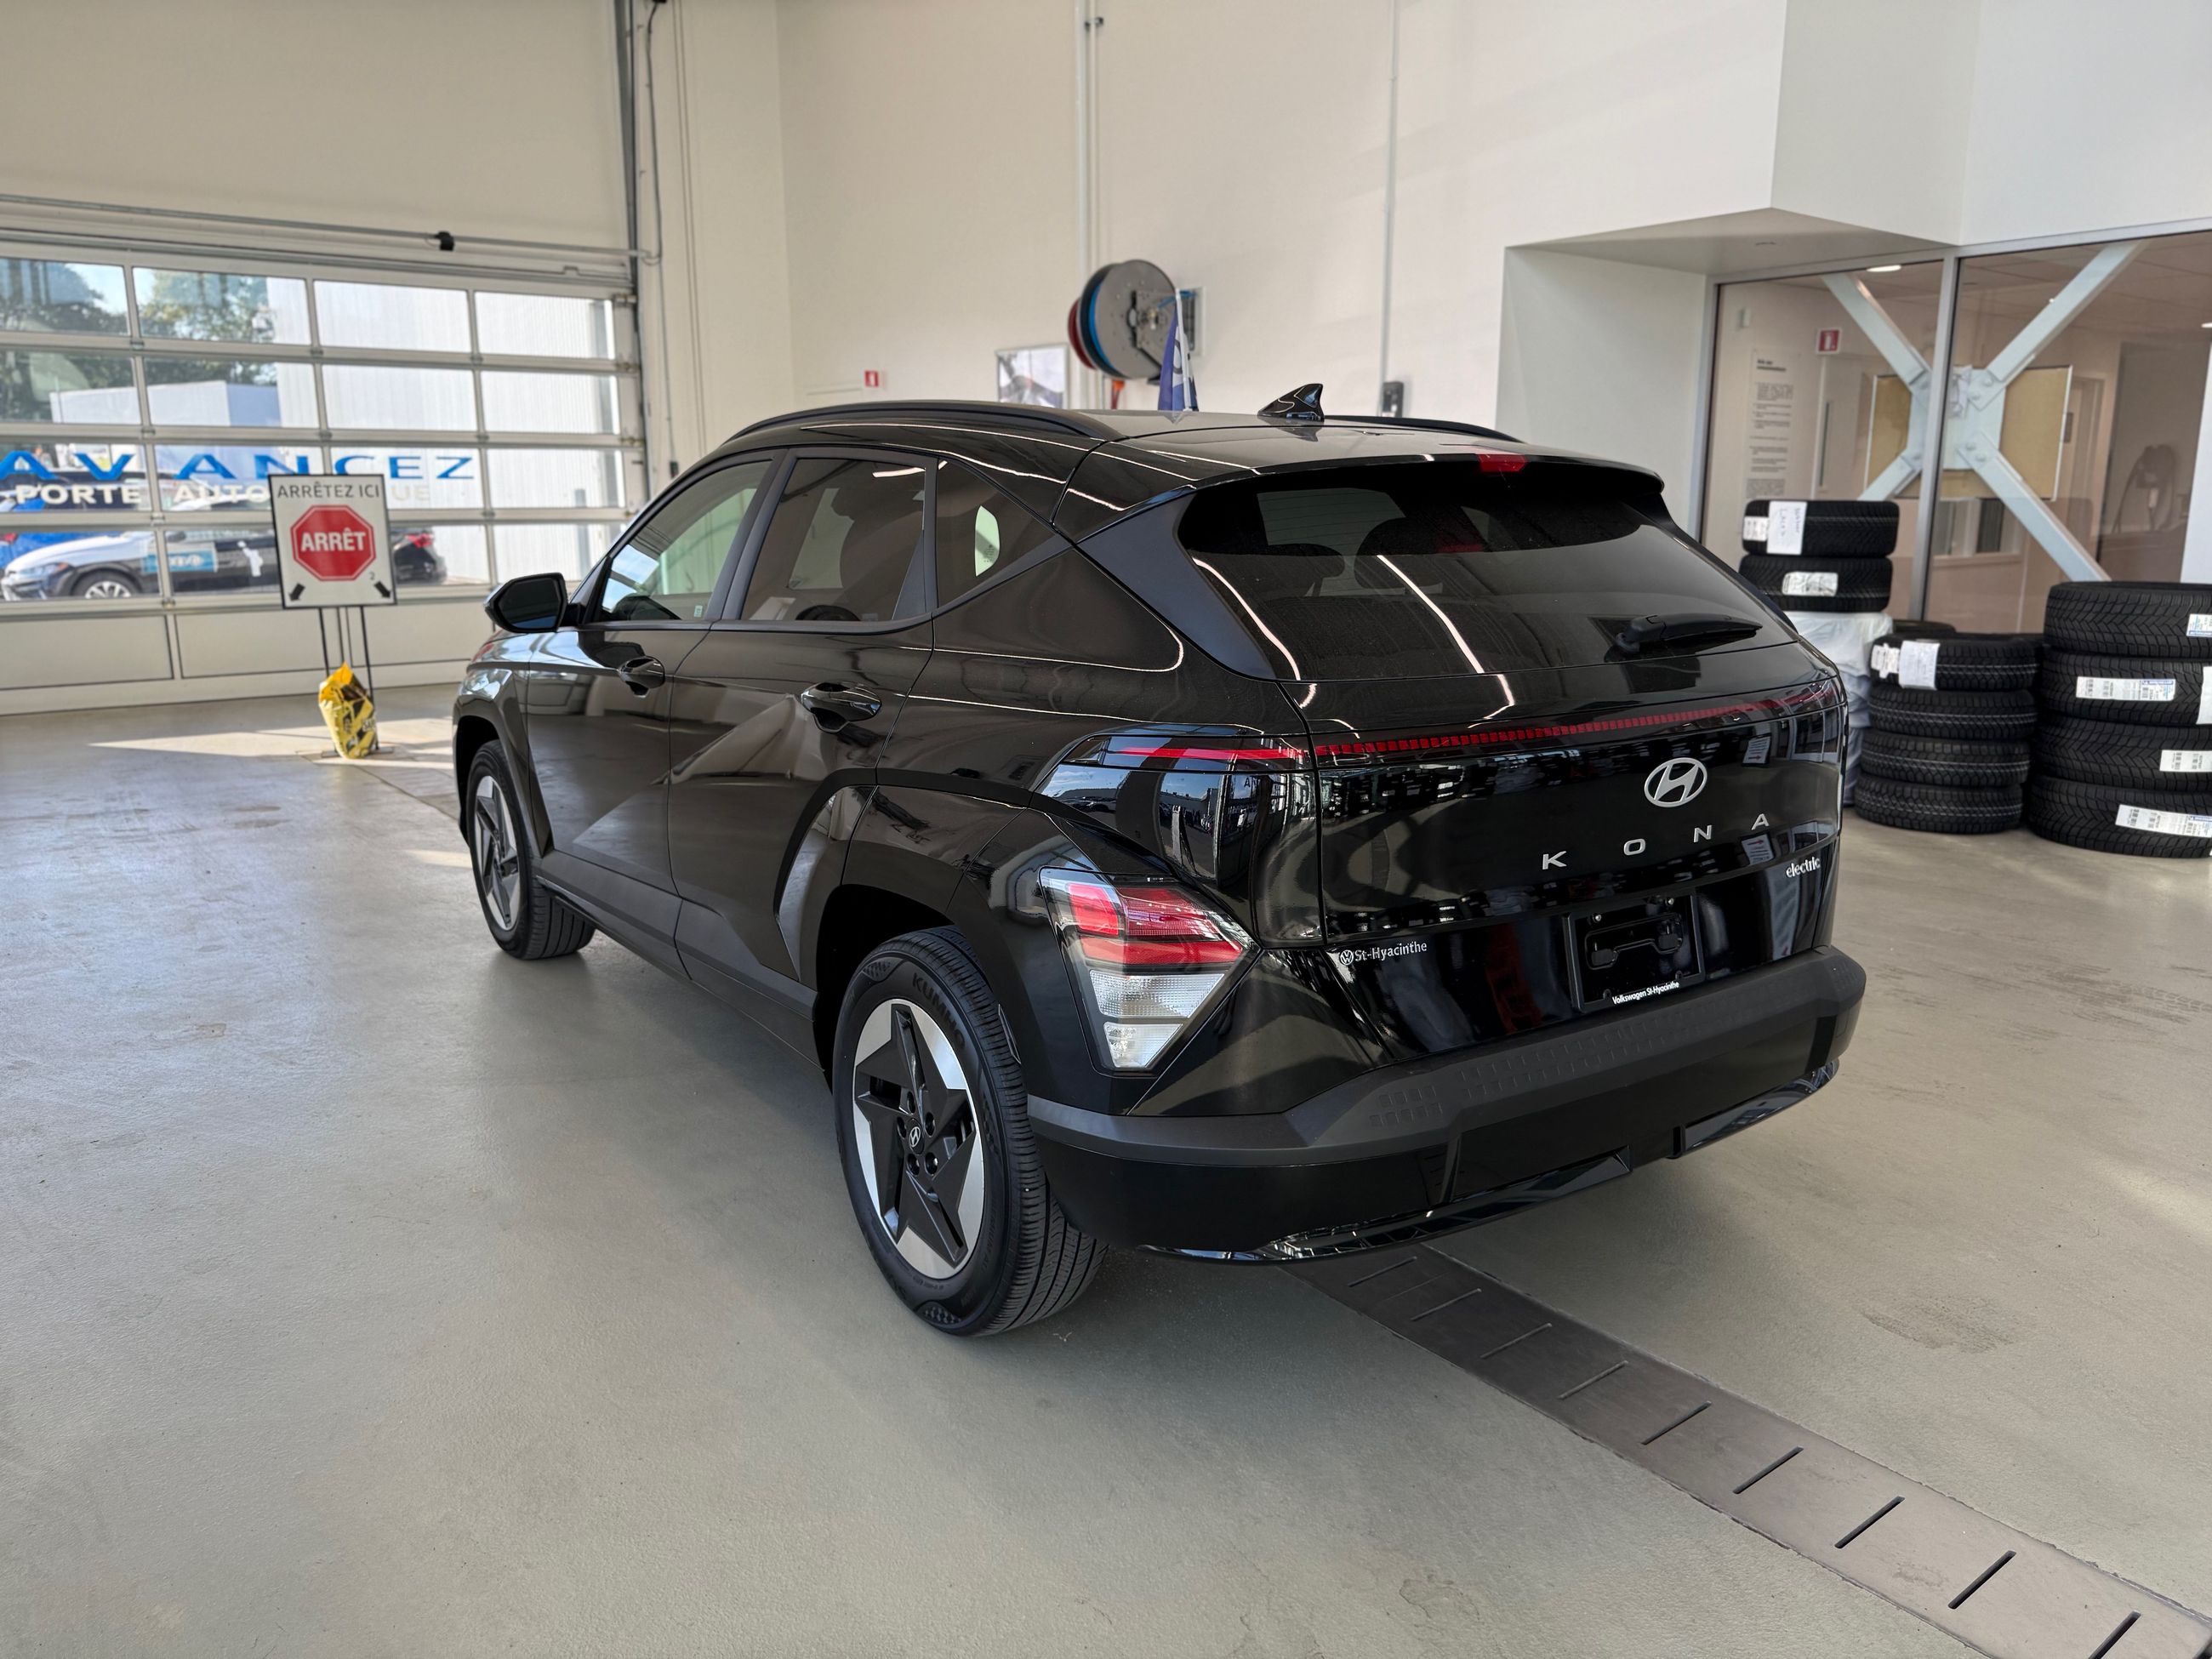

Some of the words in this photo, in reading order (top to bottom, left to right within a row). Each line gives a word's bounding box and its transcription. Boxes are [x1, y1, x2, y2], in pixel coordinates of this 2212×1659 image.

[15, 483, 142, 504] PORTE
[277, 481, 354, 499] ARRÊTEZ
[359, 484, 380, 498] ICI
[300, 527, 367, 552] ARRÊT
[1542, 812, 1770, 870] KONA
[1786, 856, 1821, 878] electric
[1355, 941, 1428, 961] St-Hyacinthe
[1612, 989, 1646, 1005] Volkswagen
[1646, 980, 1679, 995] St-Hyacinthe
